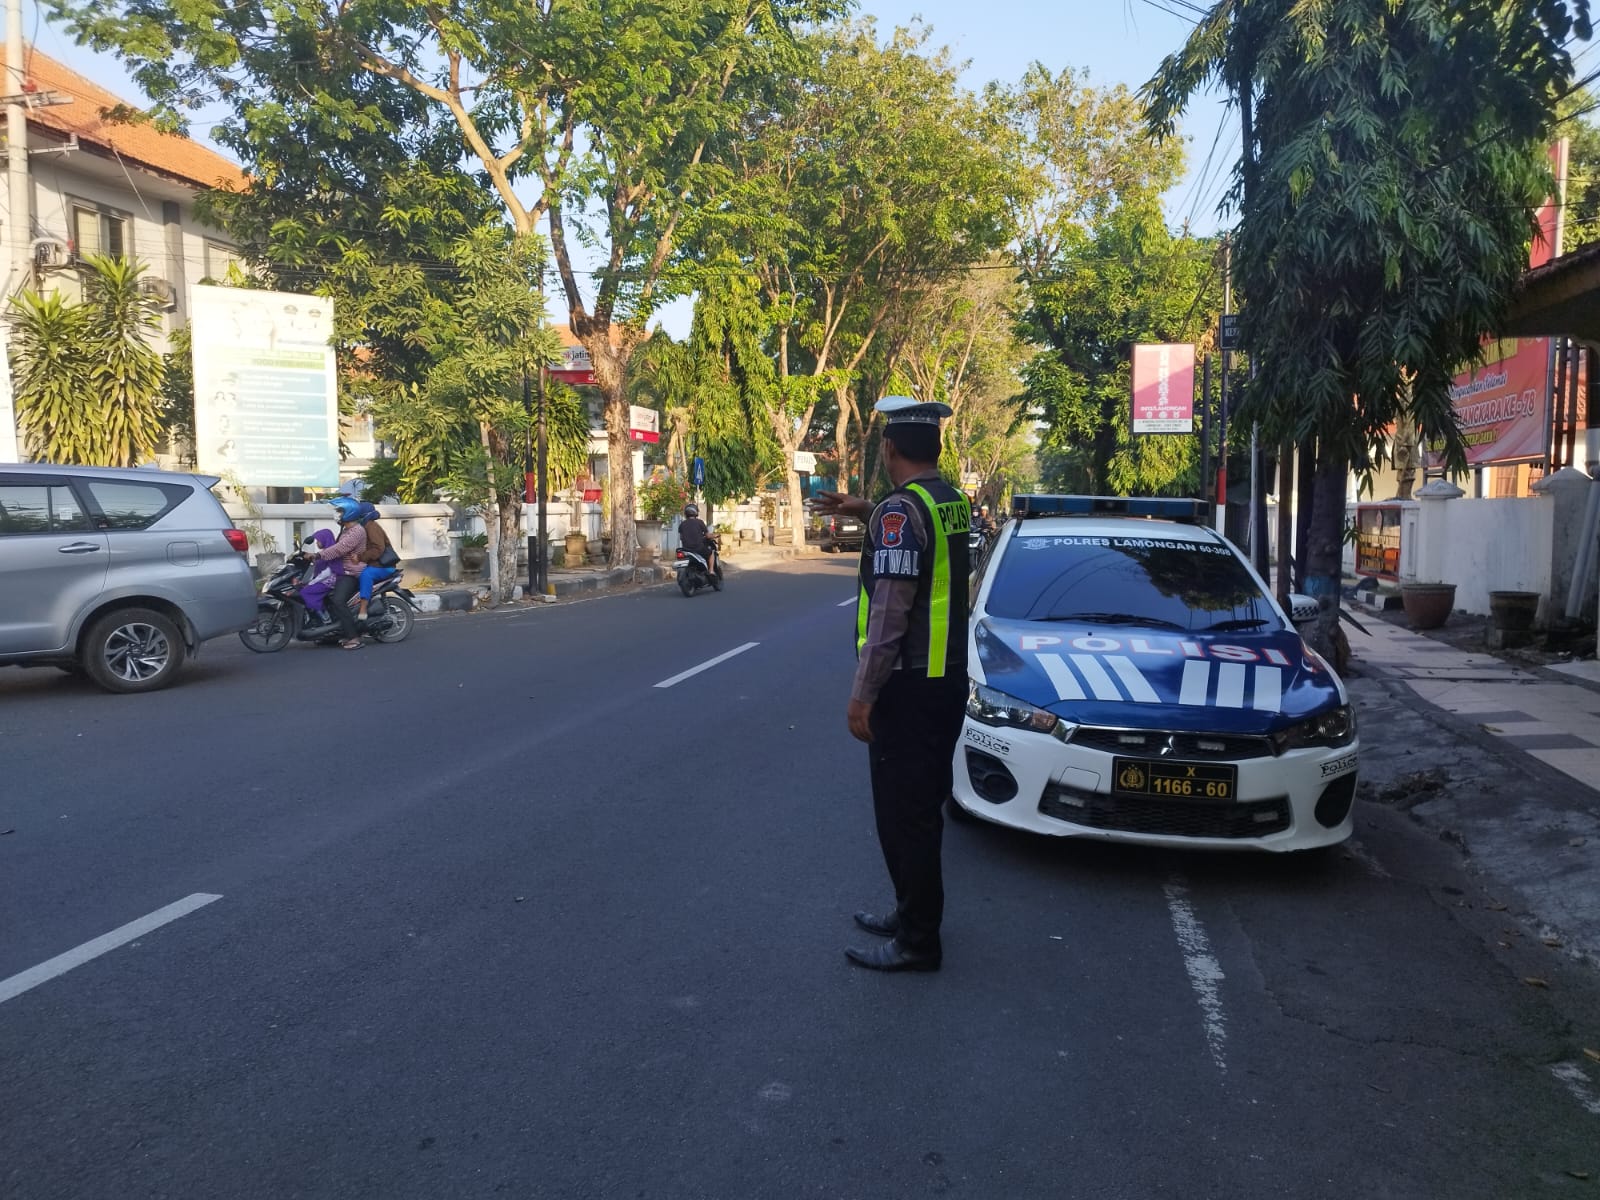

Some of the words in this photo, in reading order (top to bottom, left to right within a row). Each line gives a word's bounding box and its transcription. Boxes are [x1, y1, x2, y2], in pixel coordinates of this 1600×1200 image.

[937, 504, 970, 532] POLISI
[1054, 537, 1110, 547] POLRES
[1114, 539, 1196, 552] LAMONGAN
[1020, 636, 1292, 666] POLISI
[966, 729, 1010, 753] Police
[1186, 767, 1196, 777] X
[1154, 778, 1192, 795] 1166
[1206, 782, 1228, 797] 60
